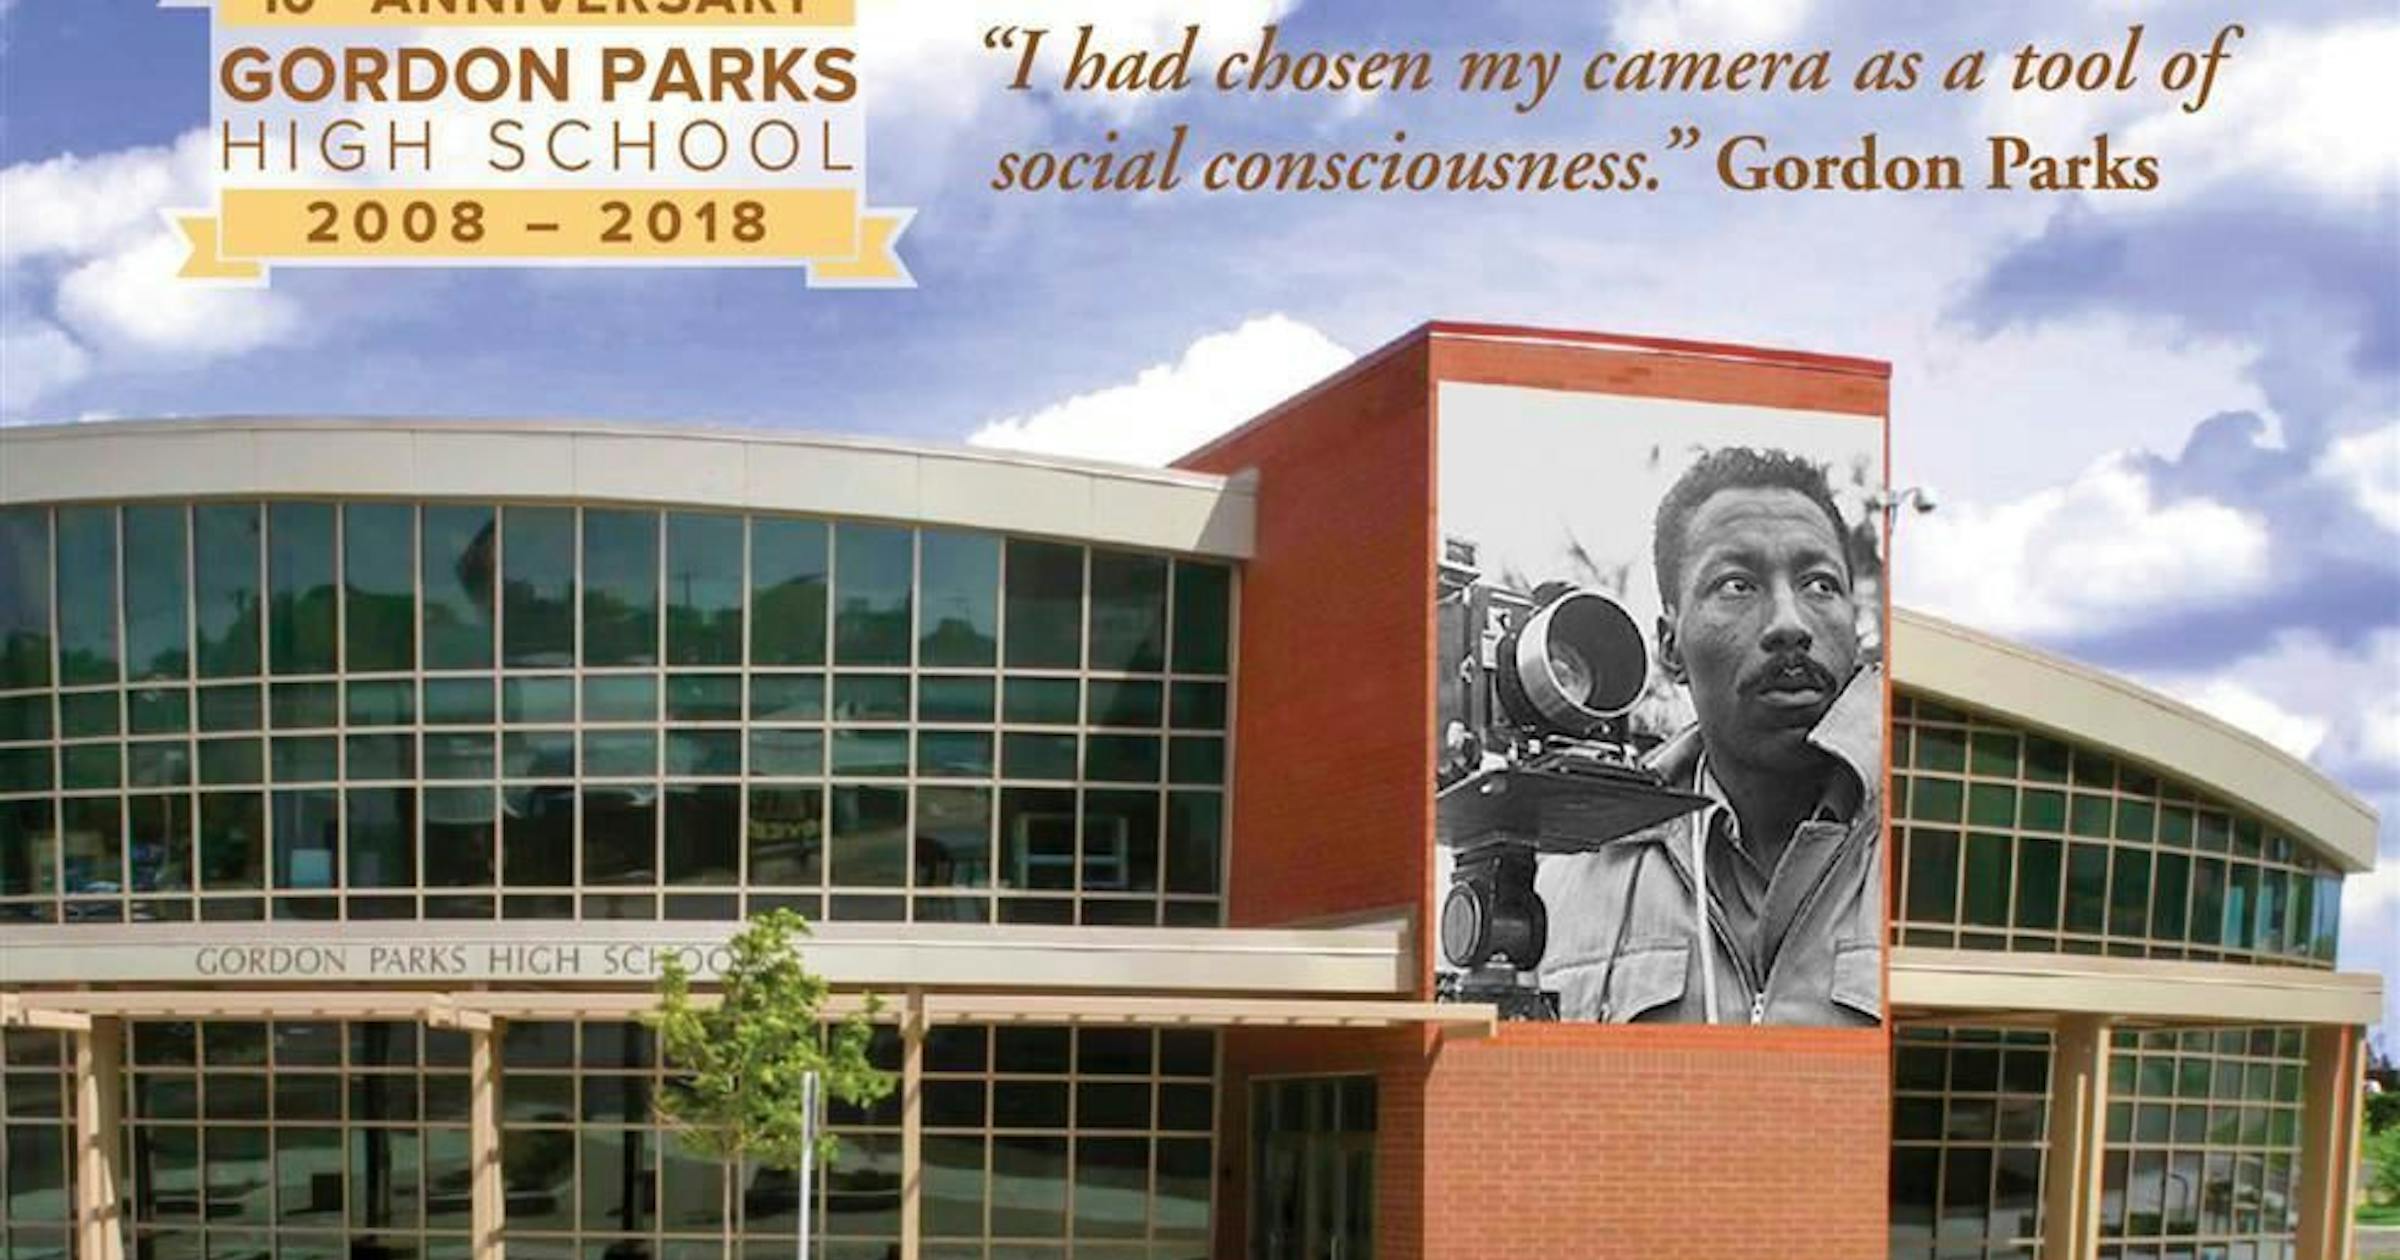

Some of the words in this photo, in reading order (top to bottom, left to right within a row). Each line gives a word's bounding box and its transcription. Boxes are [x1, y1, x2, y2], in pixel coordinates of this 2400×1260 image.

[195, 946, 347, 975] GORDON
[369, 946, 467, 974] PARKS
[489, 946, 581, 975] HIGH
